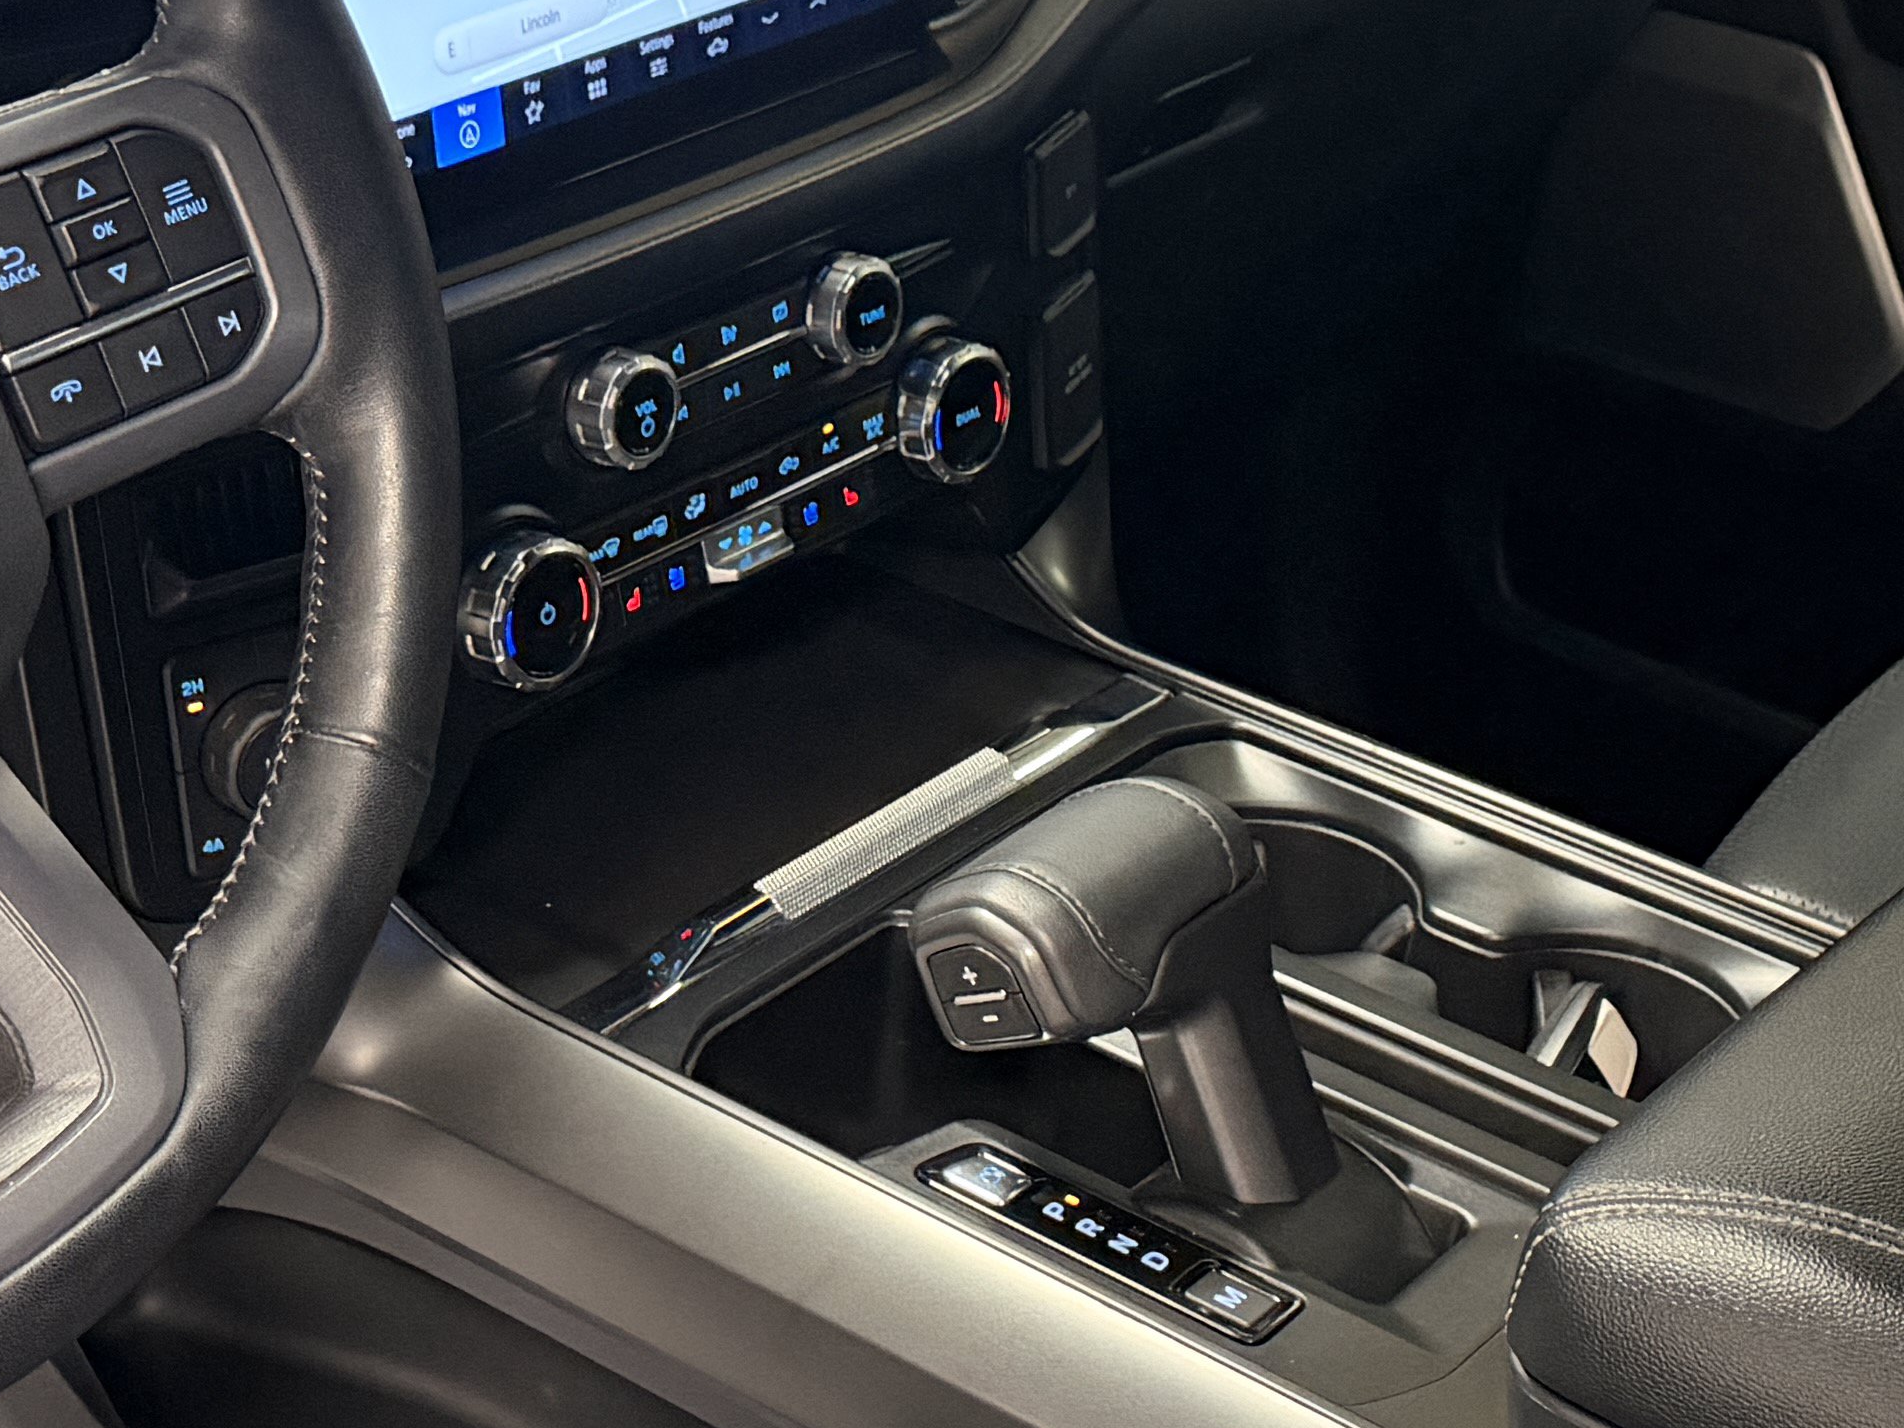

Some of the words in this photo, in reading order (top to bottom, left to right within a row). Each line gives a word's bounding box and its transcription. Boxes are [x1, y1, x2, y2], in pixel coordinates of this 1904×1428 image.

[519, 9, 562, 35] Lincoln
[584, 57, 608, 75] Apps
[457, 102, 477, 117] Nav
[396, 123, 416, 140] one
[163, 197, 208, 226] MENU
[92, 220, 118, 240] OK
[635, 399, 658, 418] VOL
[730, 476, 758, 499] AUTO
[181, 677, 205, 698] 2H
[1041, 1201, 1065, 1222] P
[1074, 1218, 1105, 1239] R
[1107, 1233, 1139, 1255] N
[1141, 1251, 1170, 1272] D
[1213, 1285, 1248, 1310] M
